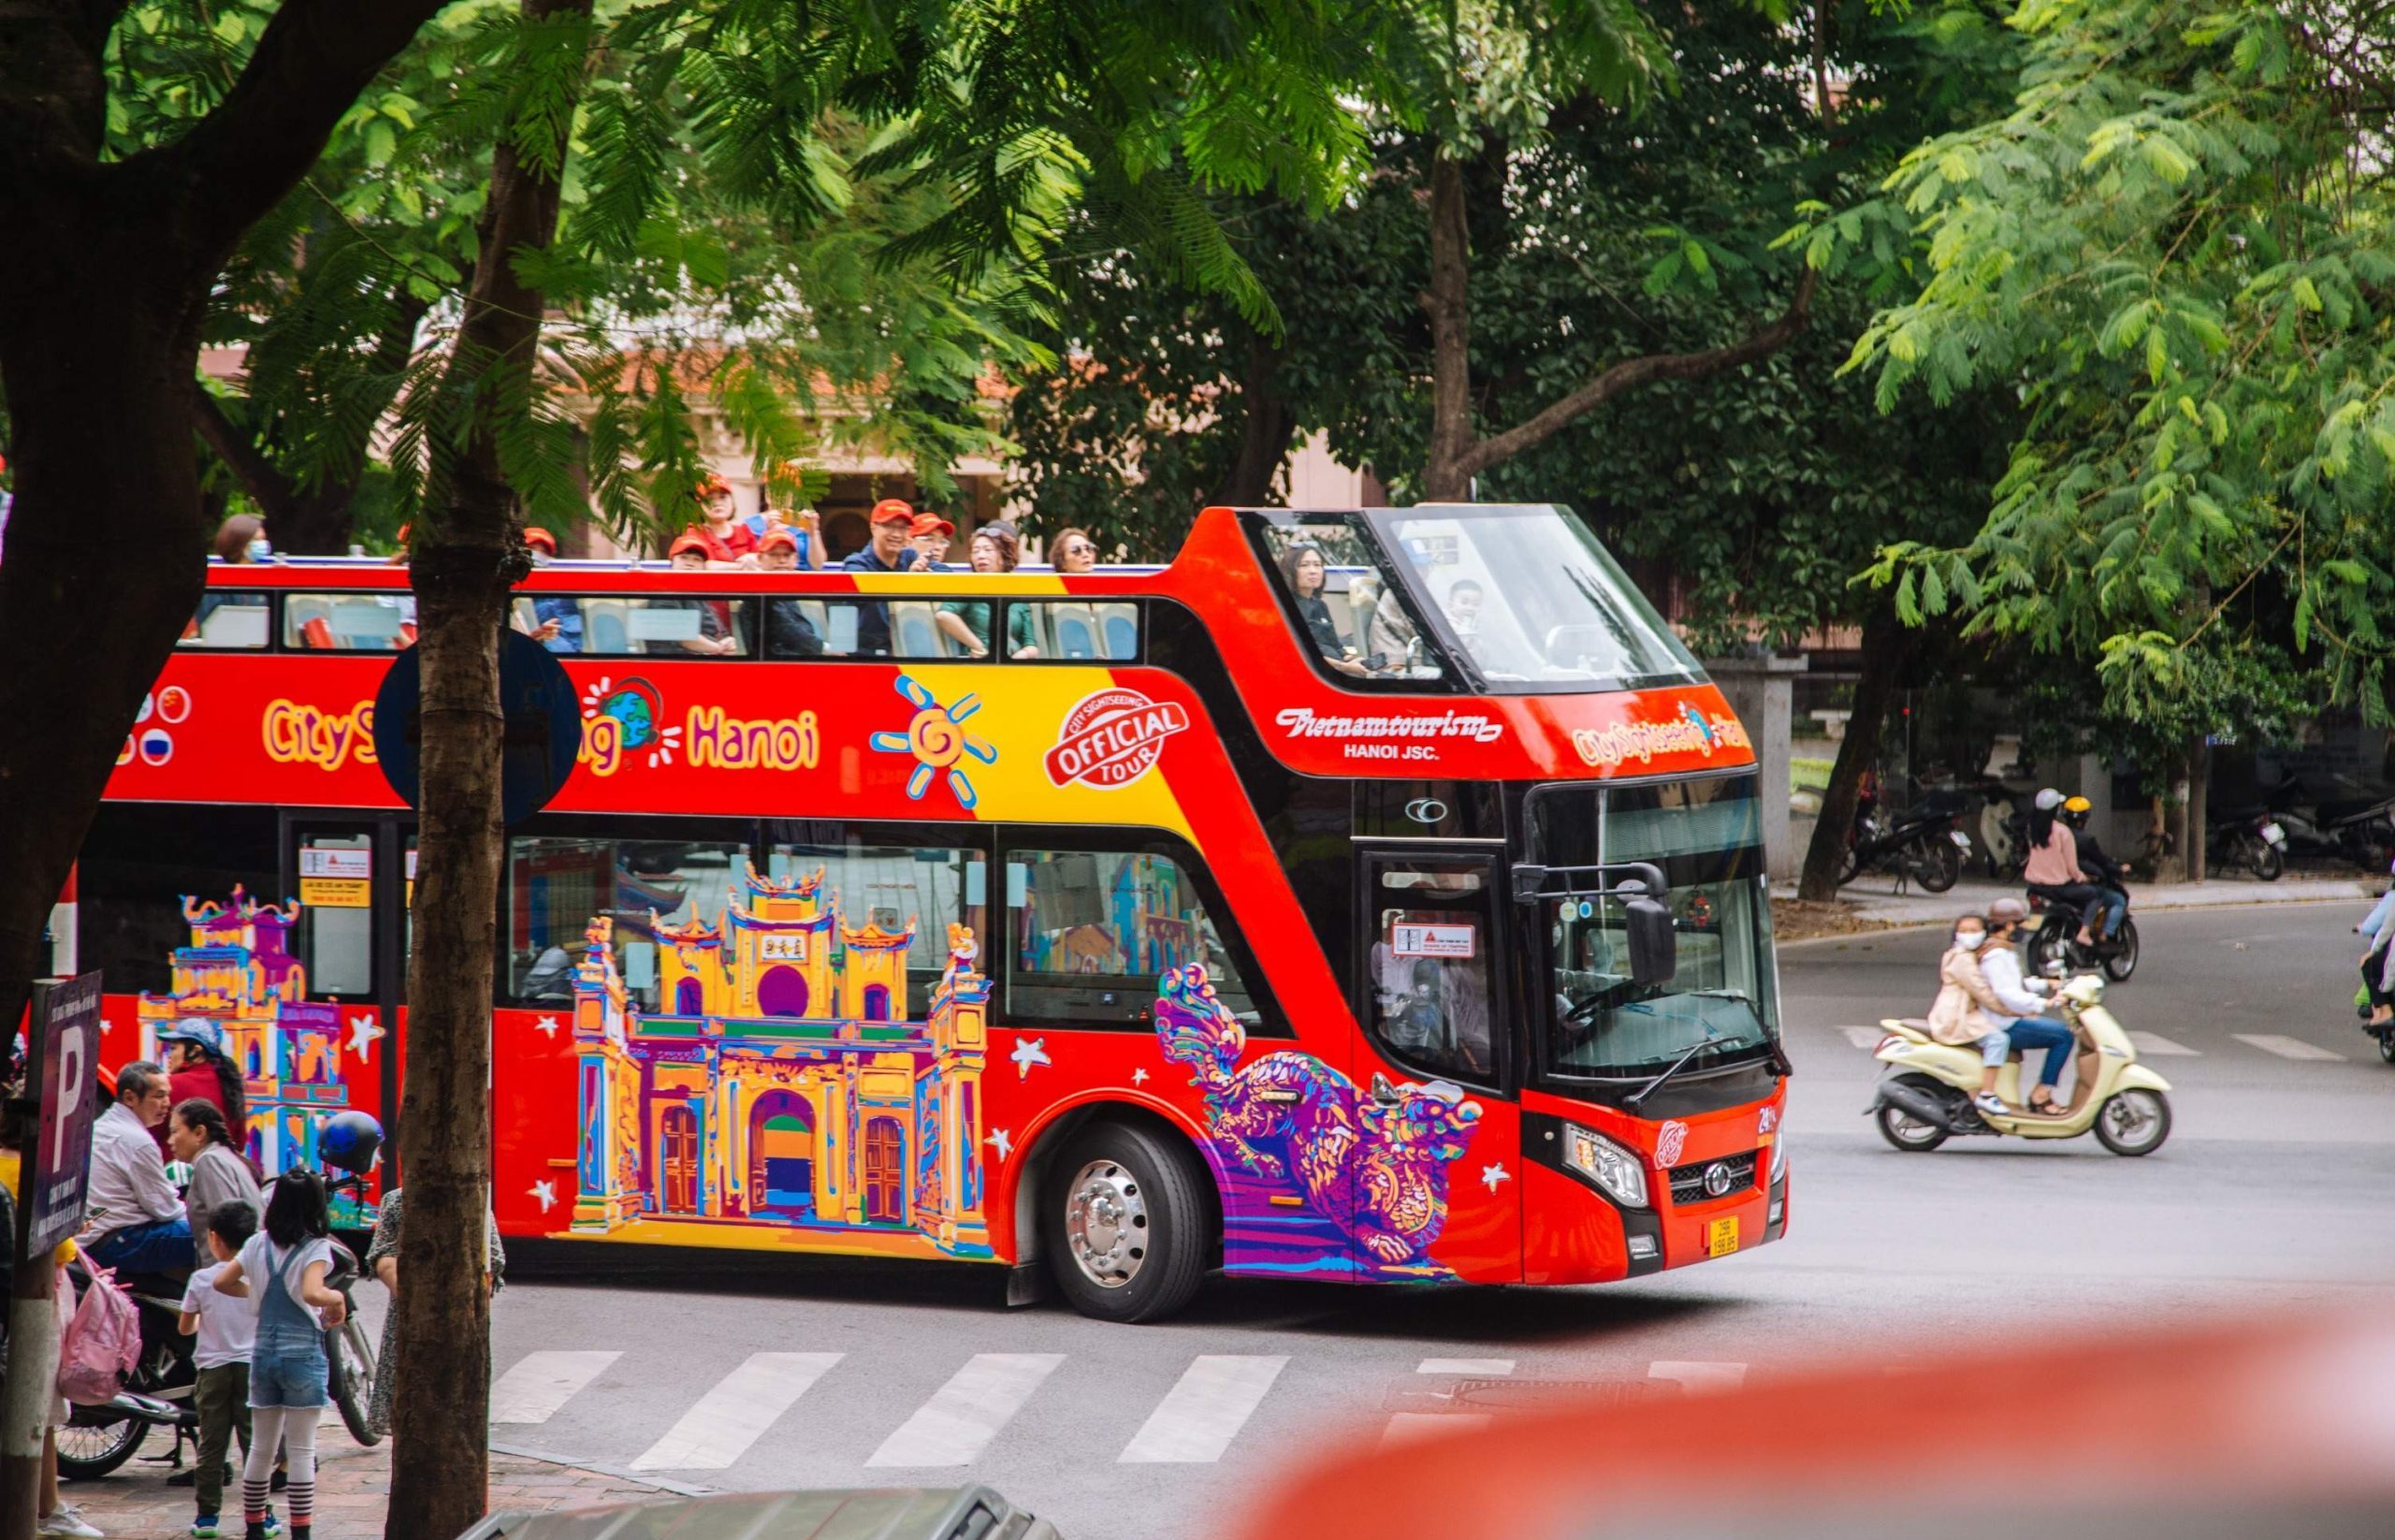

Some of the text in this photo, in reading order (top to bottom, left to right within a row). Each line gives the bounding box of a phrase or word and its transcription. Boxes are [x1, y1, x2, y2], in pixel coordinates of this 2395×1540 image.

[687, 705, 820, 771] Hanoi
[1068, 711, 1087, 734] CITY
[1275, 707, 1504, 743] Vietnamtourism
[1057, 707, 1182, 776] OFFICIAL
[1343, 744, 1441, 761] HANOI JSC.
[1100, 747, 1155, 782] TOUR
[52, 1025, 84, 1174] P
